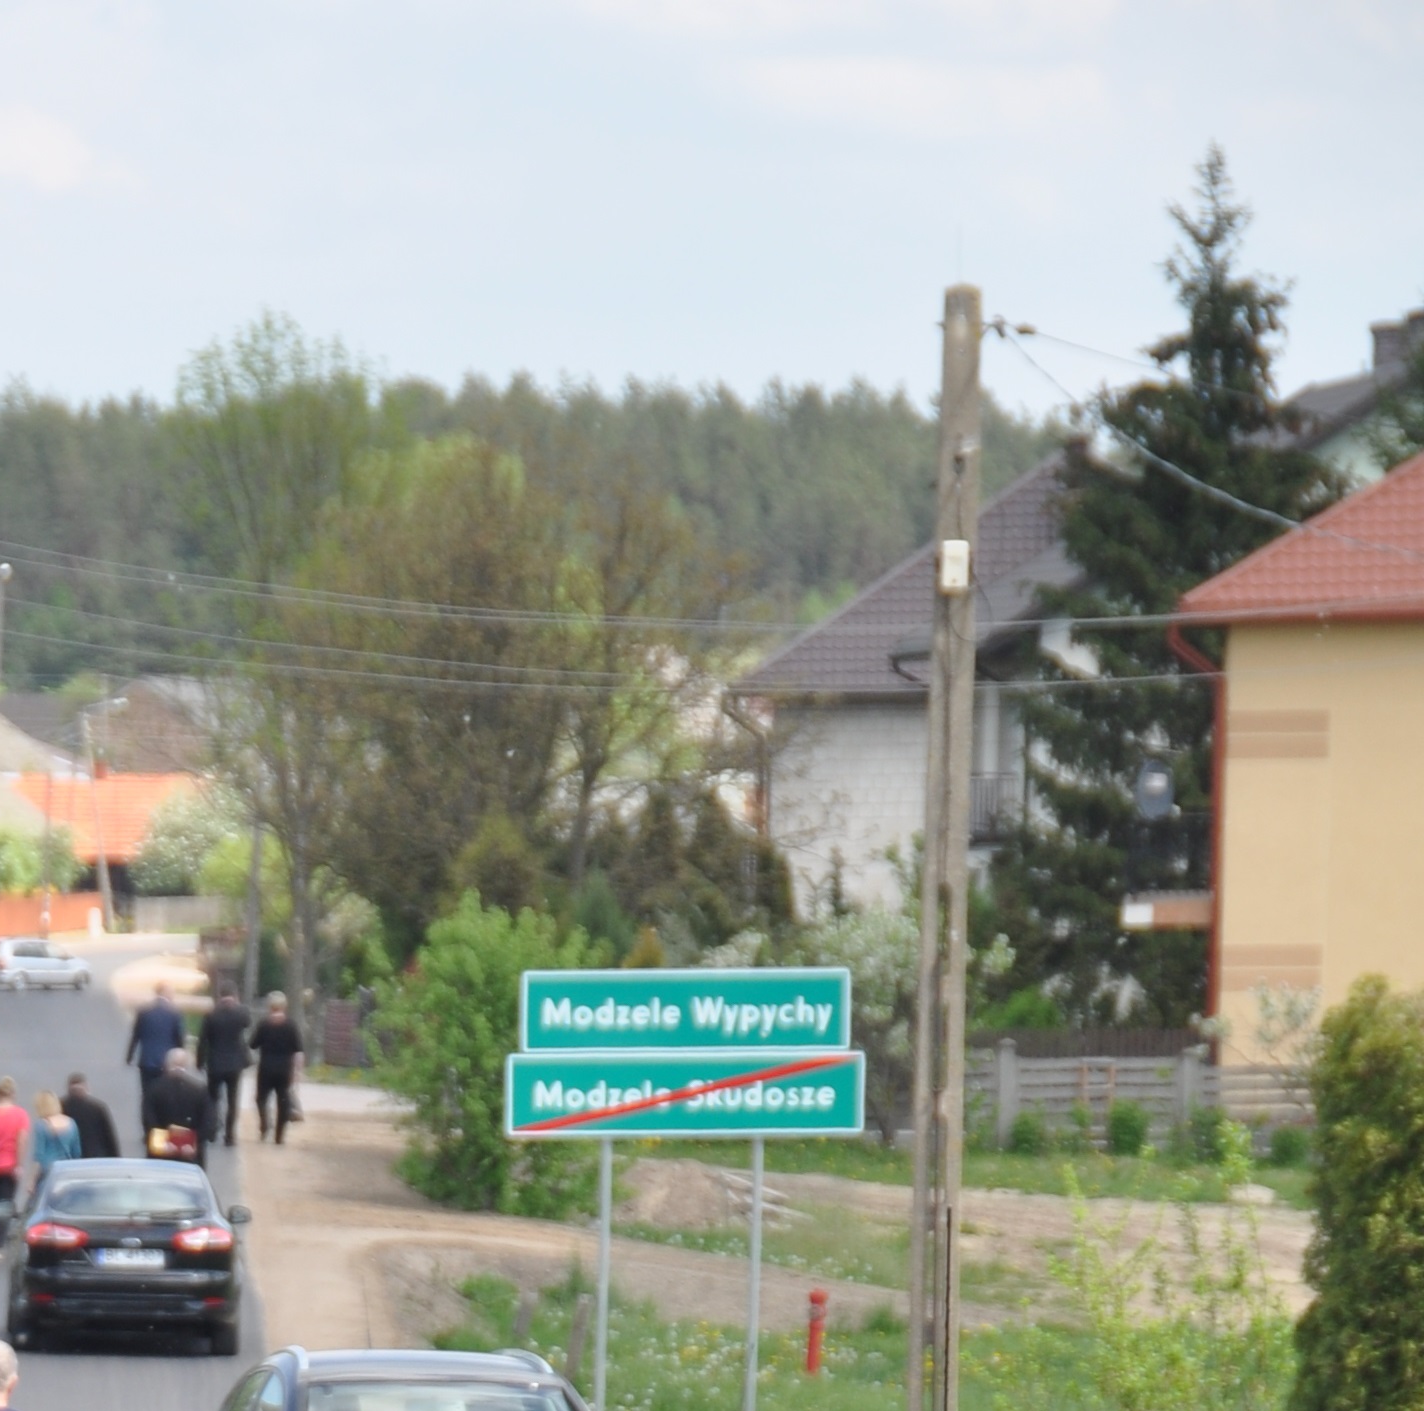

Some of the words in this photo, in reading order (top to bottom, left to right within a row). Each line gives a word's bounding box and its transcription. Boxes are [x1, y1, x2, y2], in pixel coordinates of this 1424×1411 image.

[541, 997, 681, 1028] Modzele
[691, 995, 833, 1036] Wypychy
[533, 1080, 672, 1111] Modzele
[685, 1080, 836, 1111] Skudosze
